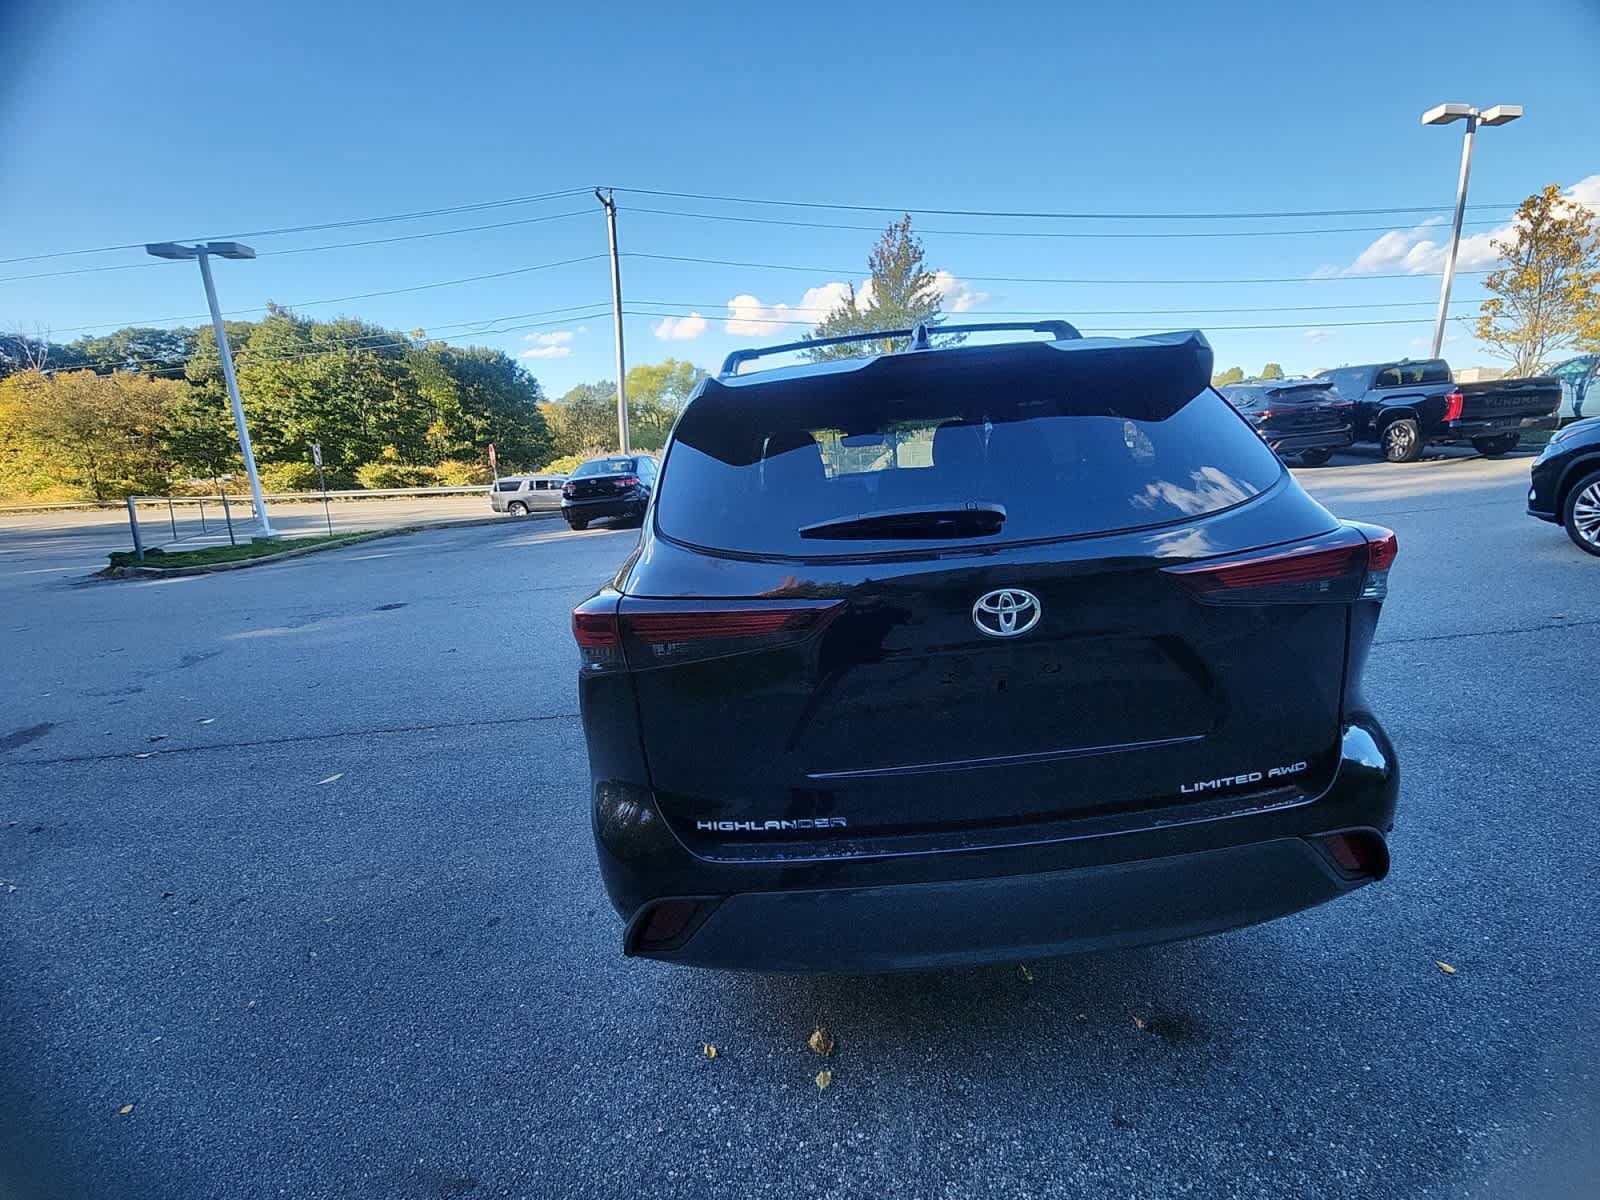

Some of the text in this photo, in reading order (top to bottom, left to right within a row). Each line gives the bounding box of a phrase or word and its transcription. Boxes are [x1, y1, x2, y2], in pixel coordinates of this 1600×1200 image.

[1180, 761, 1307, 793] LIMITED AWD
[697, 817, 847, 831] HIGHLANDER
